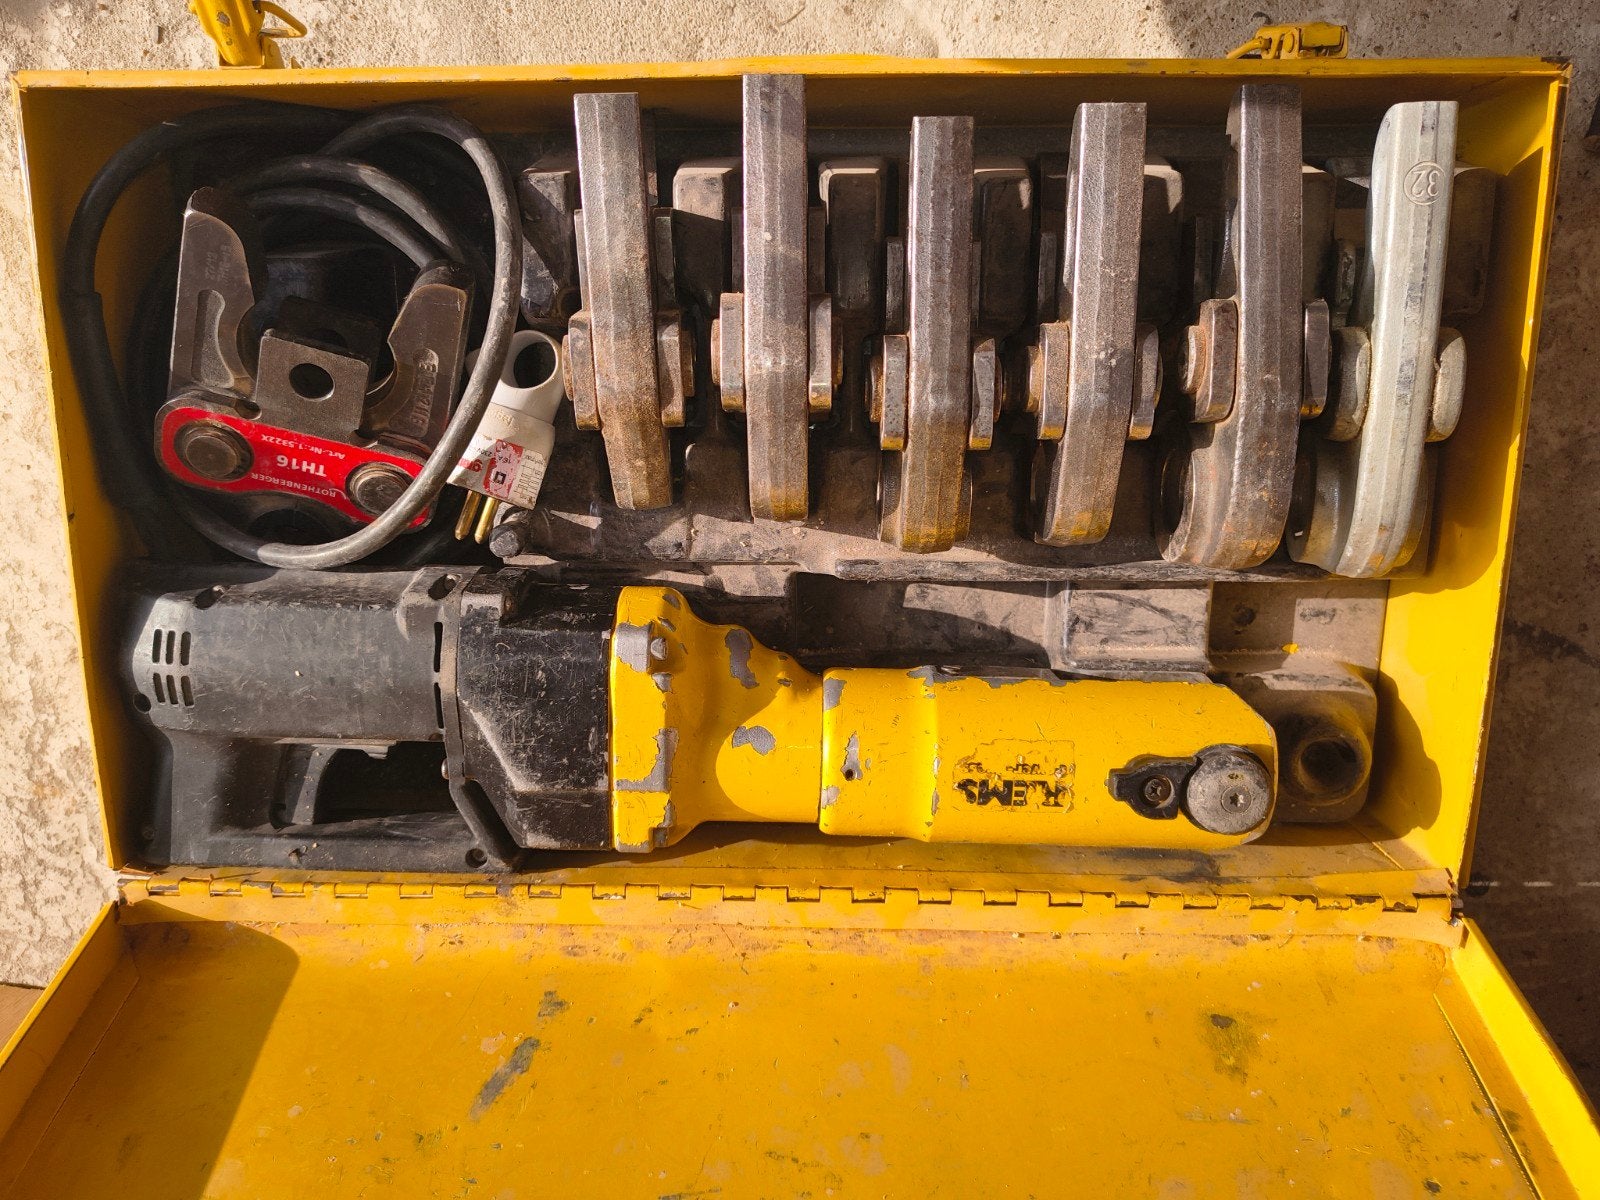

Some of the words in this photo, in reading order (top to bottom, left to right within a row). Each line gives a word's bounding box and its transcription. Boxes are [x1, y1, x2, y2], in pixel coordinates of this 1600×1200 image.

[1411, 169, 1440, 198] 32
[276, 454, 327, 477] TH16
[250, 472, 336, 498] ROTHENBERGER
[953, 778, 1064, 808] REMS
